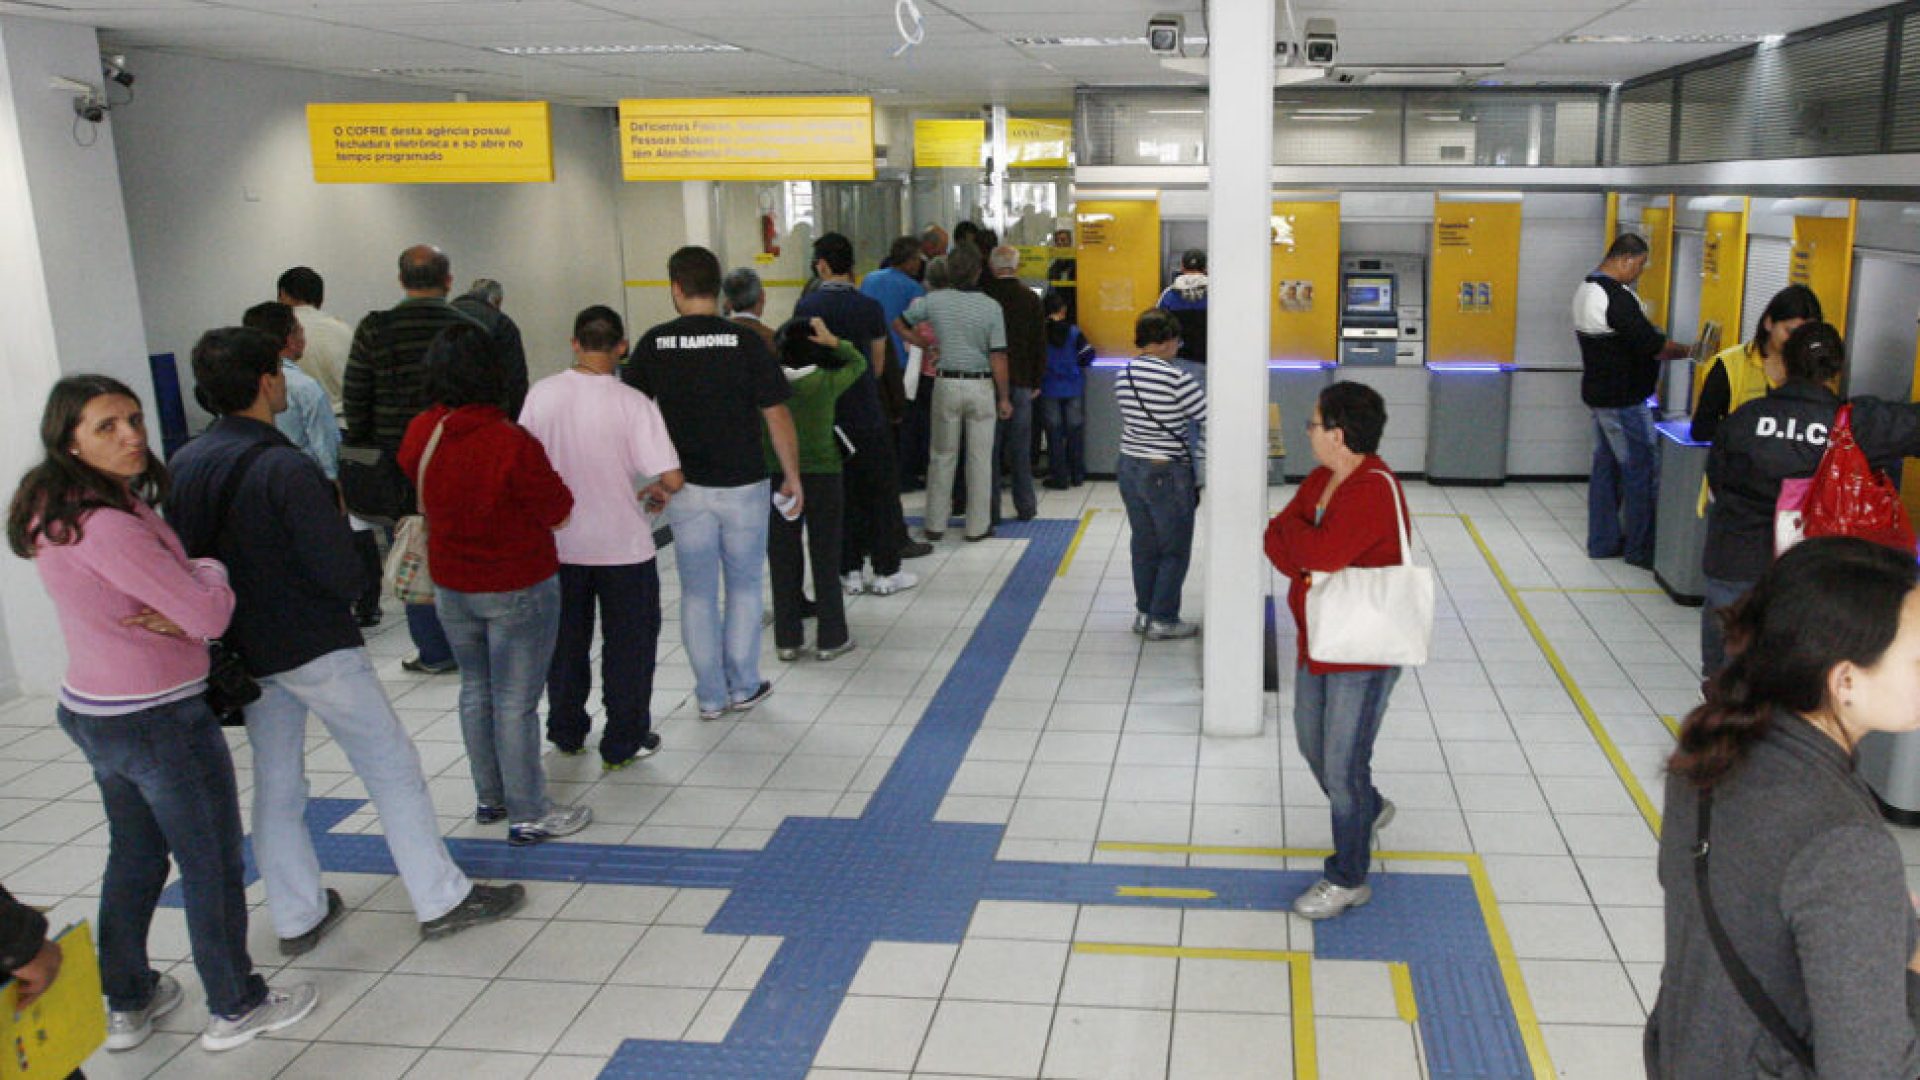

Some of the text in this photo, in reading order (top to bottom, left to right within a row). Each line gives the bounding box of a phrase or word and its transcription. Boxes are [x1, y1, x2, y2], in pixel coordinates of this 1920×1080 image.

[333, 125, 344, 136] O
[346, 125, 387, 136] COFRE
[390, 125, 423, 136] desta
[473, 126, 512, 138] possui
[630, 121, 690, 132] Deficientes
[335, 138, 391, 149] fechadura
[453, 140, 459, 149] e
[480, 137, 506, 149] abre
[508, 140, 524, 149] no
[630, 135, 676, 146] Pessoas
[336, 150, 443, 163] tempo programado
[656, 333, 739, 350] THE RAMONES
